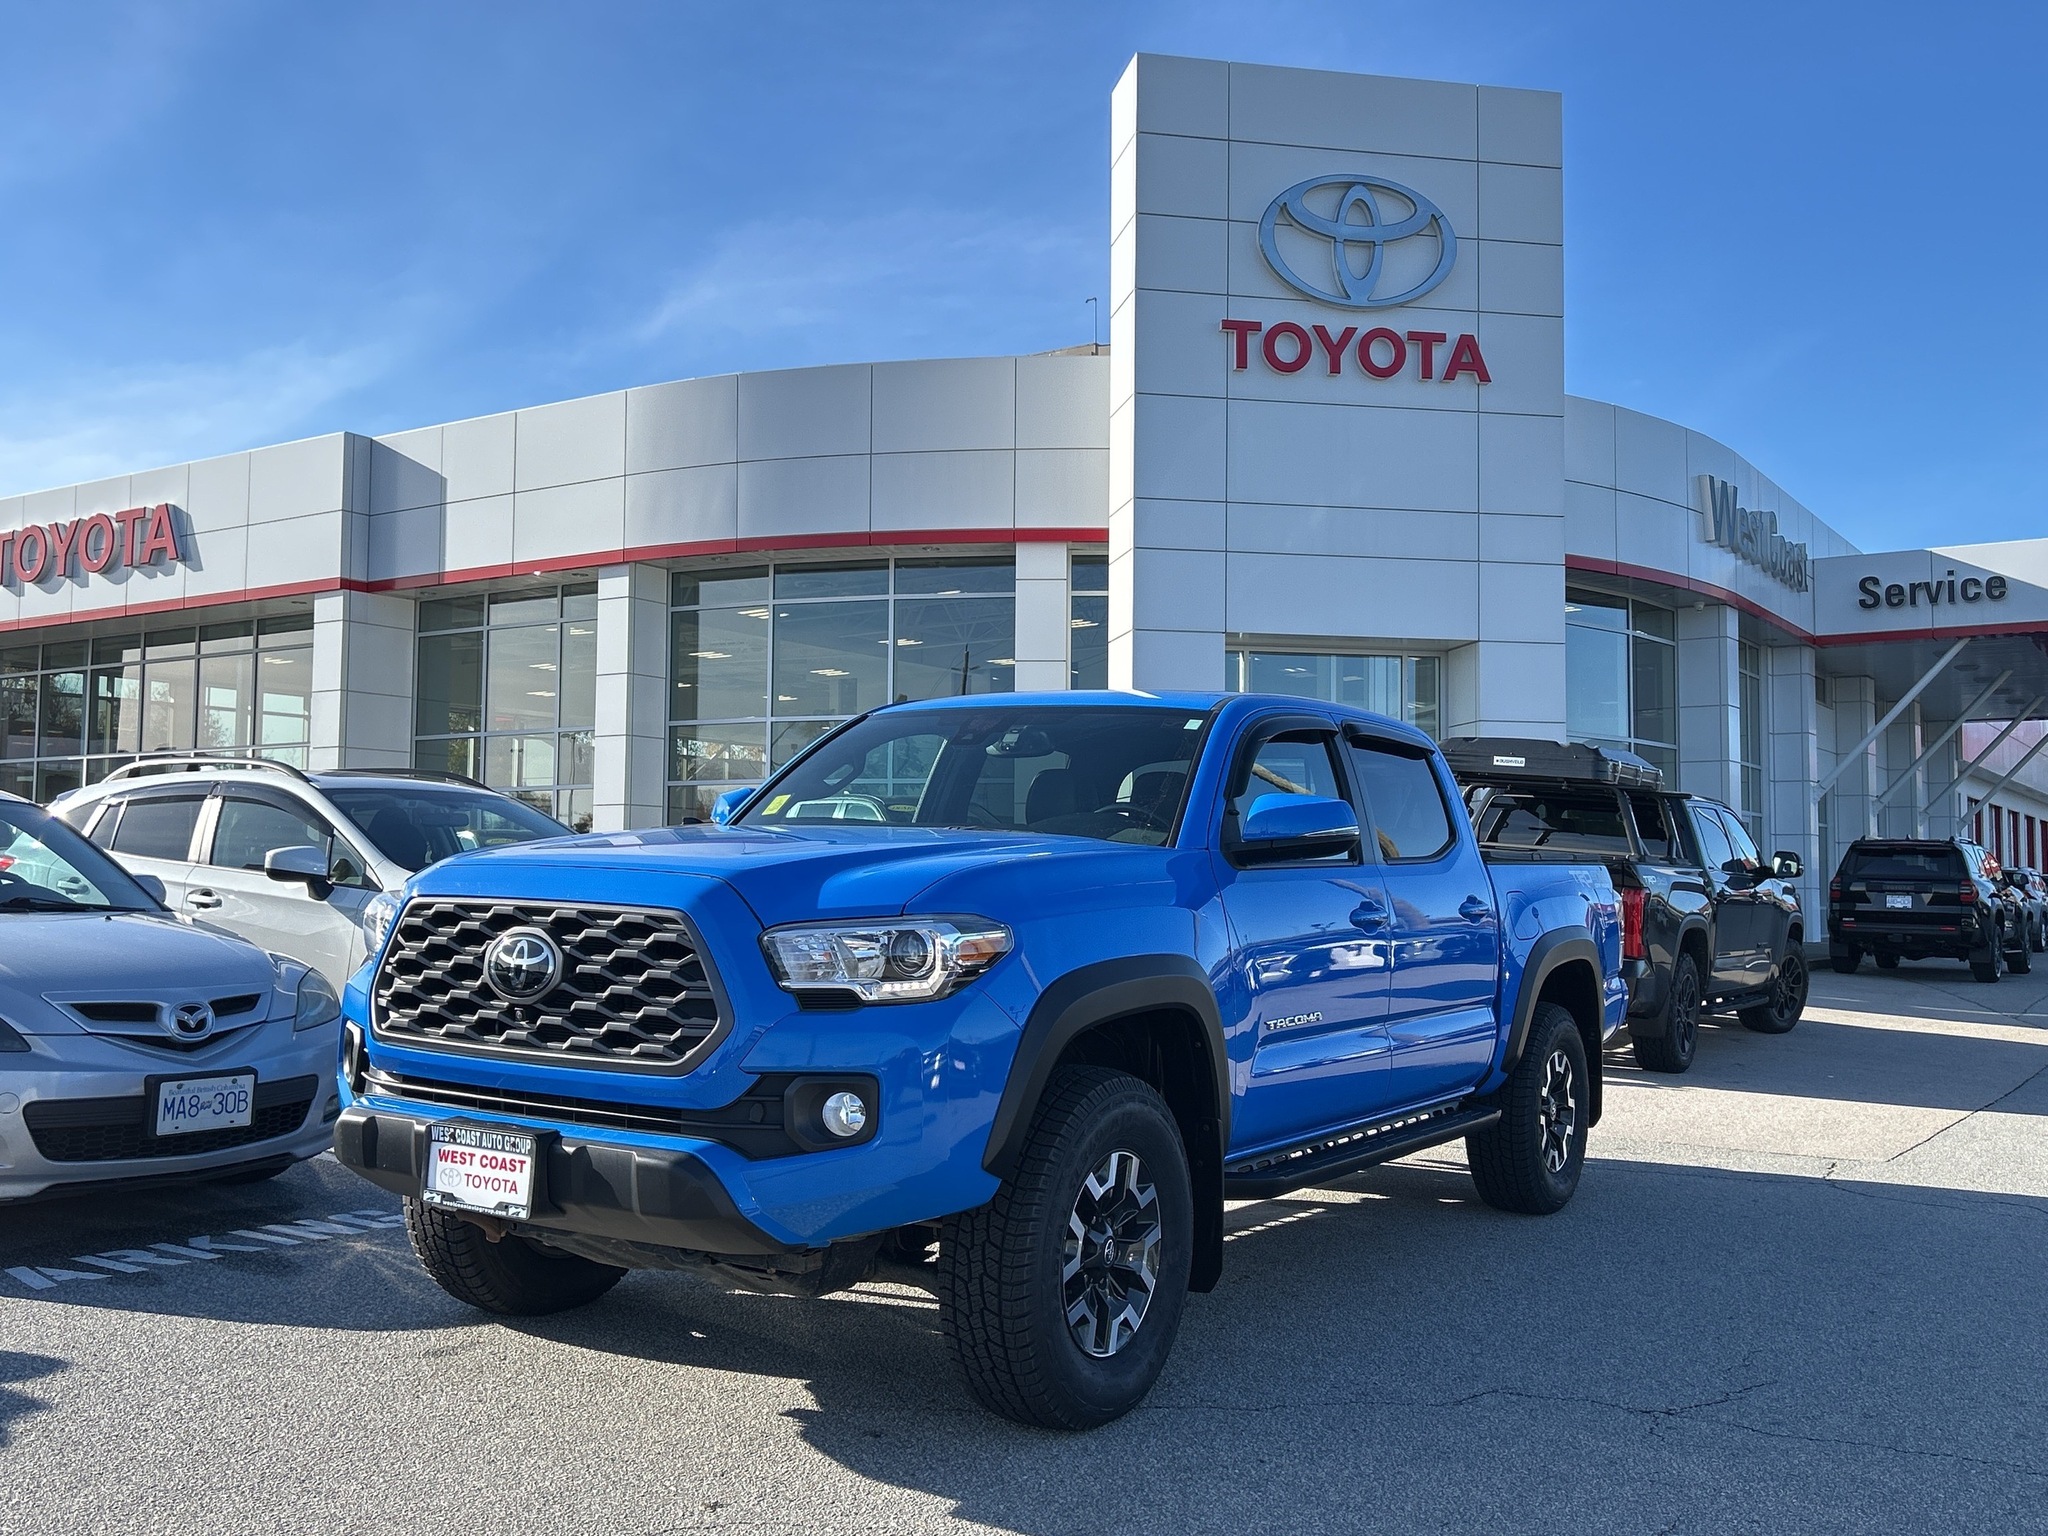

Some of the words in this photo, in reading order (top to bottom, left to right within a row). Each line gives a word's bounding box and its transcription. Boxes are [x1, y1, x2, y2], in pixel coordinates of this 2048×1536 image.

[1219, 319, 1492, 384] TOYOTA
[1857, 569, 2009, 609] Service
[1265, 1011, 1323, 1031] TACOMA
[163, 1095, 200, 1121] MA8
[212, 1090, 248, 1115] 30B
[455, 1128, 481, 1147] COAST
[482, 1132, 503, 1150] AUTO
[438, 1148, 476, 1166] WEST
[480, 1154, 527, 1174] COAST
[464, 1173, 518, 1195] TOYOTA
